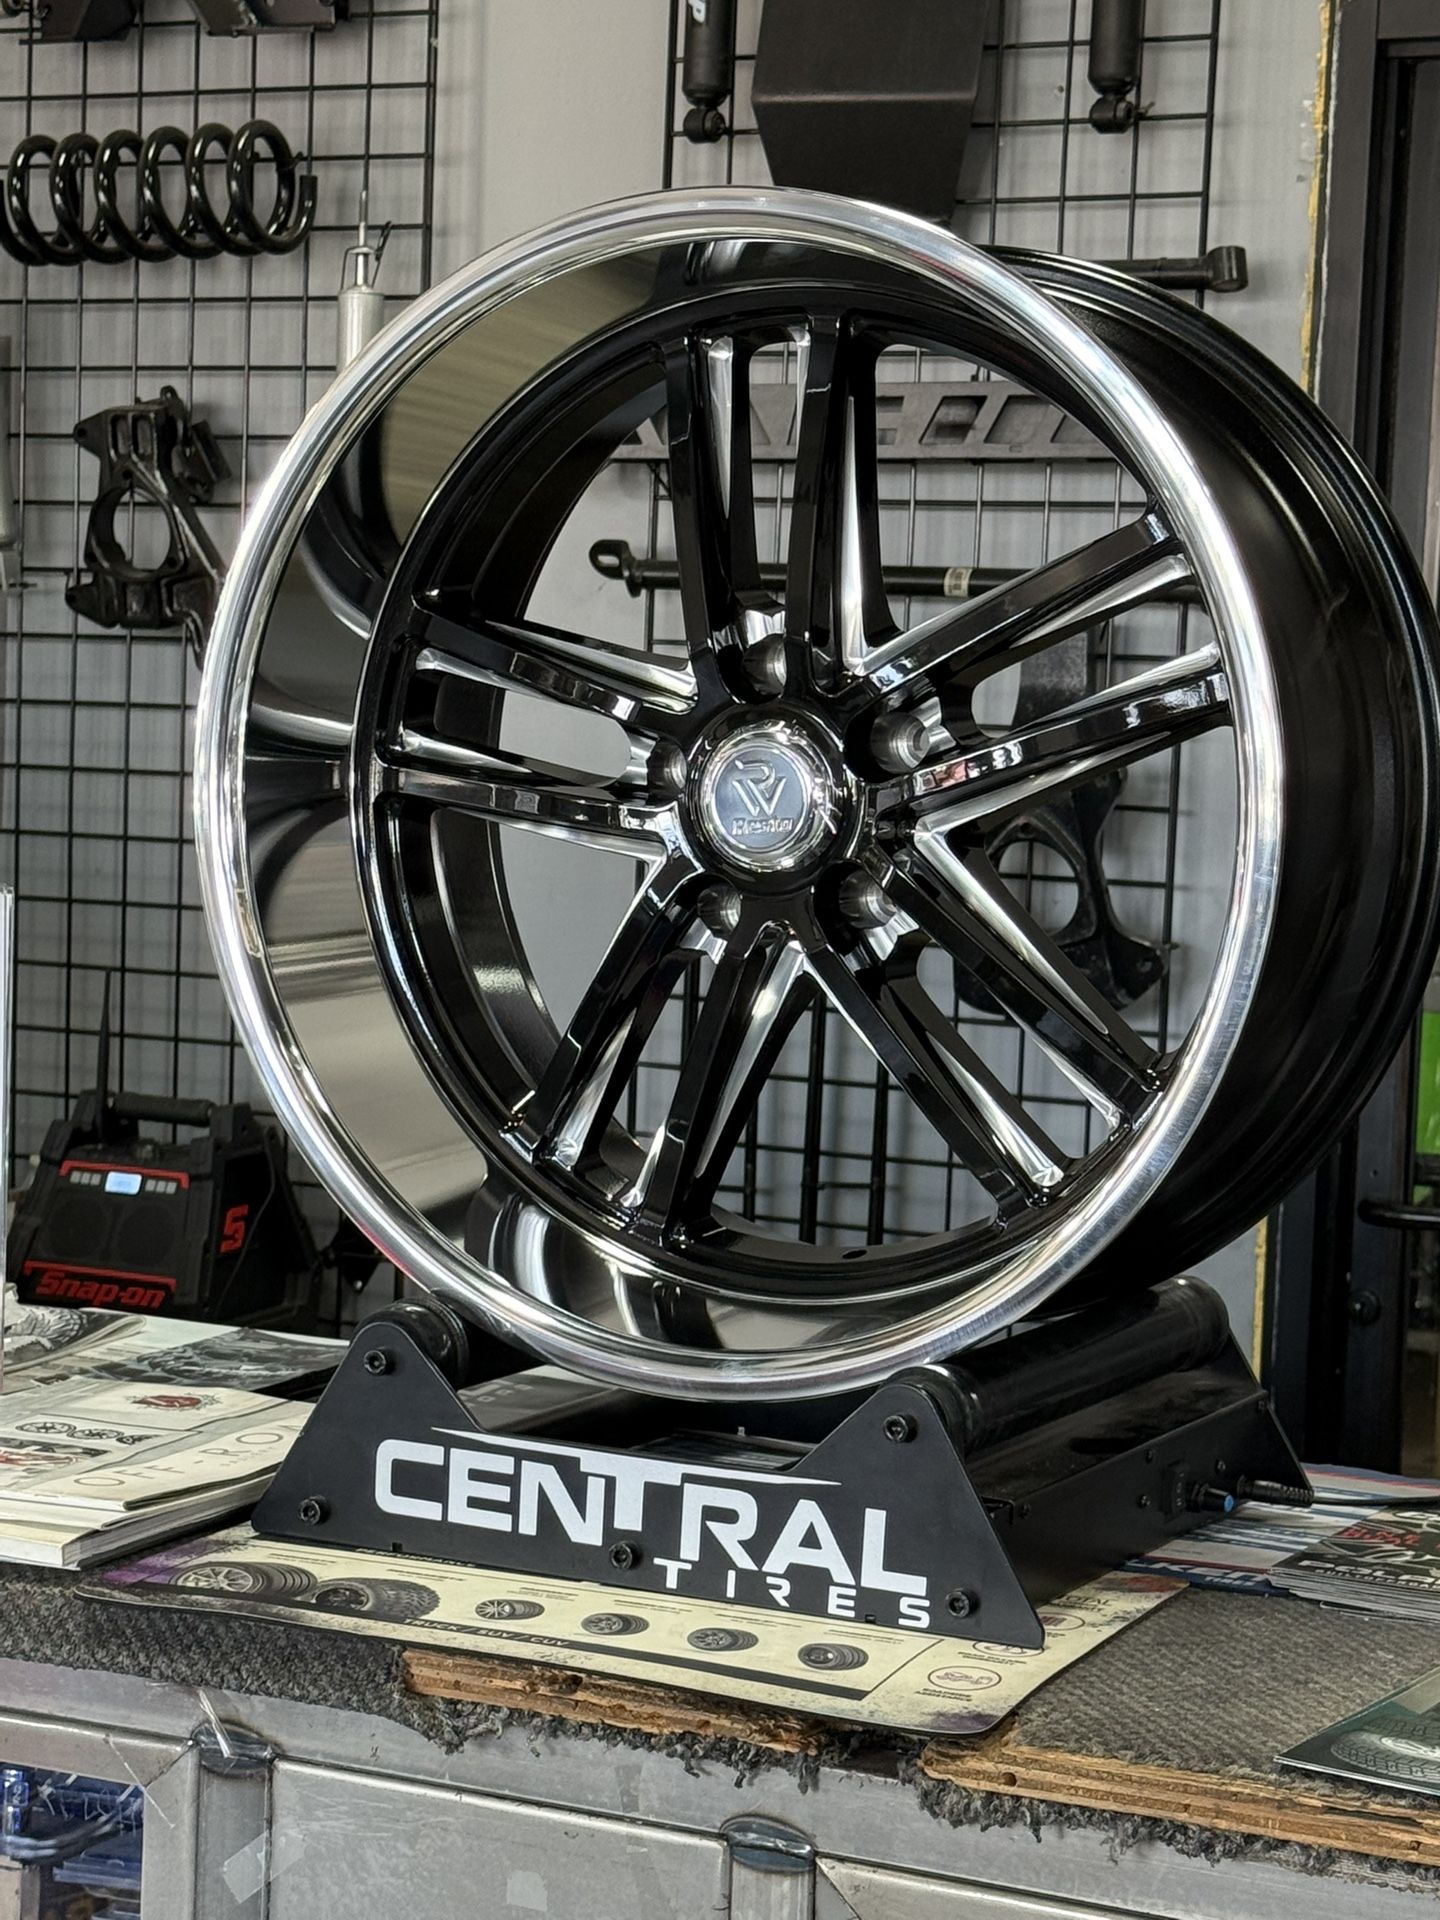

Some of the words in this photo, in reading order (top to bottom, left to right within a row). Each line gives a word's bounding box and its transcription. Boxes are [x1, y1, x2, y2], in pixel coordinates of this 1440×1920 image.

[36, 1272, 166, 1310] Snap-on
[375, 1427, 929, 1594] CENTRAL
[1298, 1559, 1440, 1585] POLA
[653, 1558, 931, 1629] TIRES
[402, 1617, 459, 1632] TRUCK
[476, 1629, 513, 1640] SUV
[529, 1636, 569, 1648] CUV
